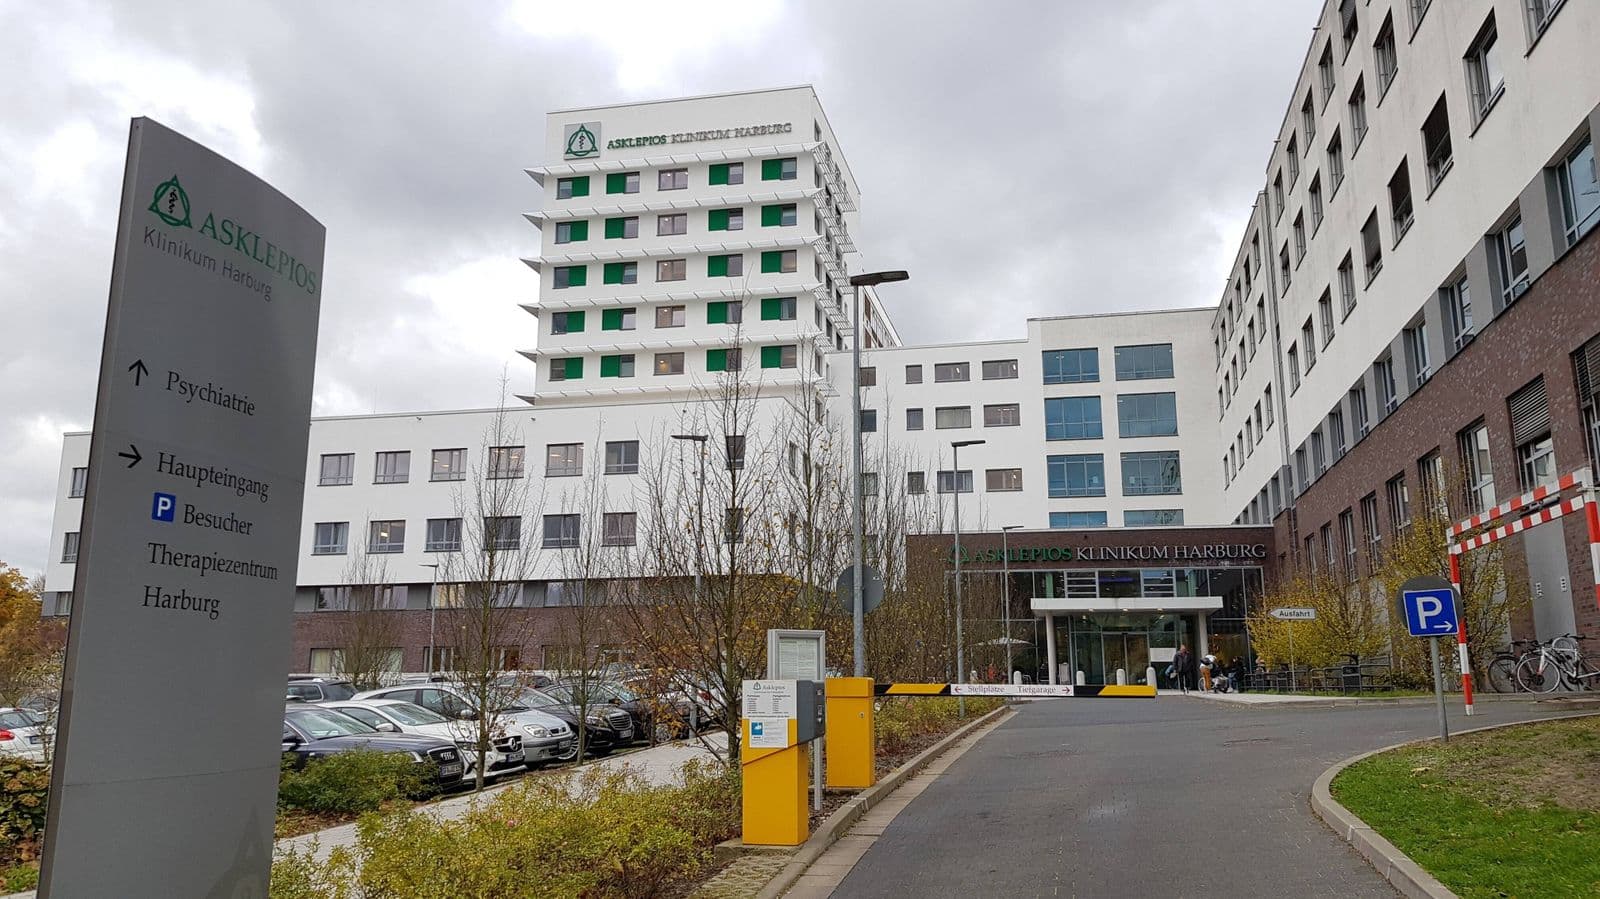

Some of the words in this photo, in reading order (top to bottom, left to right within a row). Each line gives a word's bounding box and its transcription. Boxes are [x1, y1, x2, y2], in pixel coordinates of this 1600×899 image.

[606, 134, 667, 150] ASKLEPIOS
[670, 128, 730, 144] KLINIKUM
[734, 122, 792, 139] HARBURG
[143, 226, 217, 272] Klinikum
[221, 260, 272, 302] Harburg
[198, 211, 317, 295] ASKLEPIOS
[165, 370, 256, 416] Psychiatrie
[156, 452, 270, 503] Haupteingang
[156, 496, 171, 517] P
[183, 503, 253, 535] Besucher
[148, 542, 279, 581] Therapiezentrum
[973, 546, 1073, 562] ASKLEPIOS
[1076, 545, 1169, 561] KLINIKUM
[1173, 543, 1266, 560] HARBURG
[142, 585, 221, 620] Harburg
[1279, 610, 1311, 618] Ausfahrt
[1416, 596, 1443, 630] P
[1018, 685, 1057, 695] Tiefgarage
